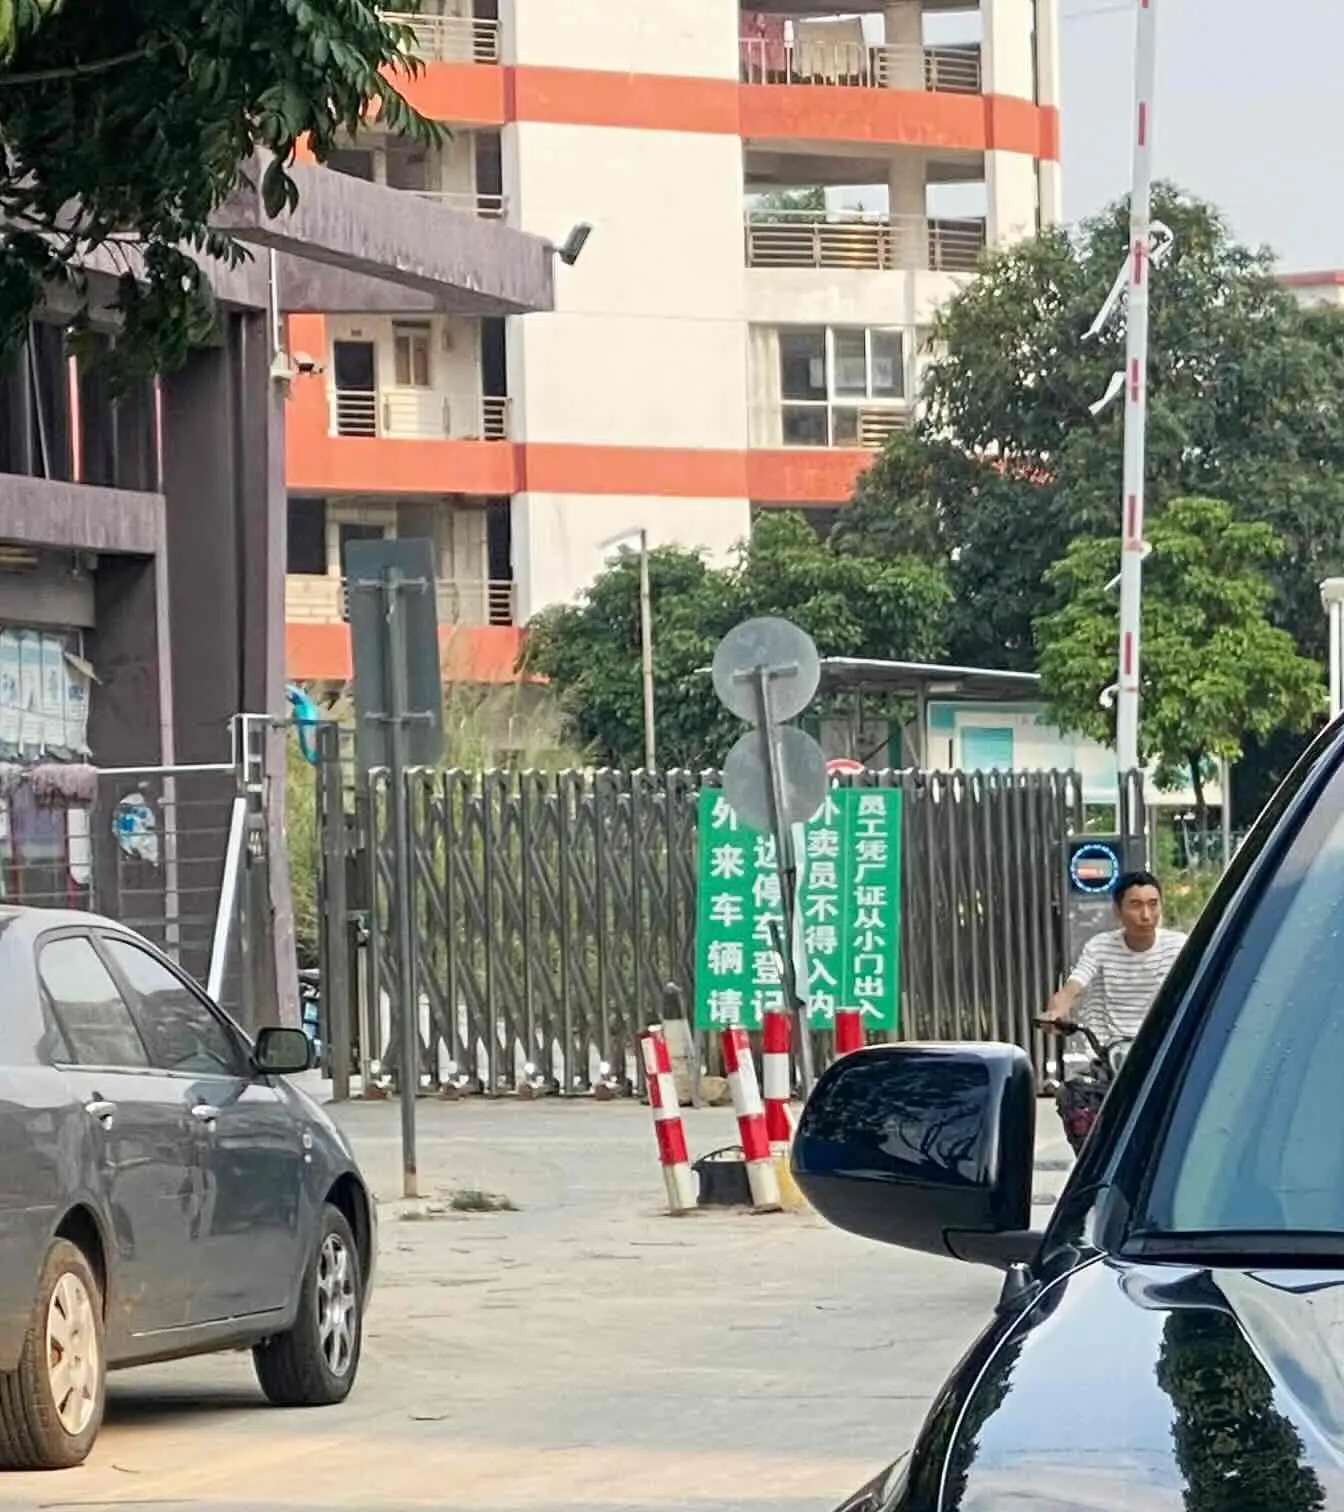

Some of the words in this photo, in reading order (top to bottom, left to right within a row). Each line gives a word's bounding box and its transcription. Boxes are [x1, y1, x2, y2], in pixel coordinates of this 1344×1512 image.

[707, 796, 745, 1024] 外来车辆请
